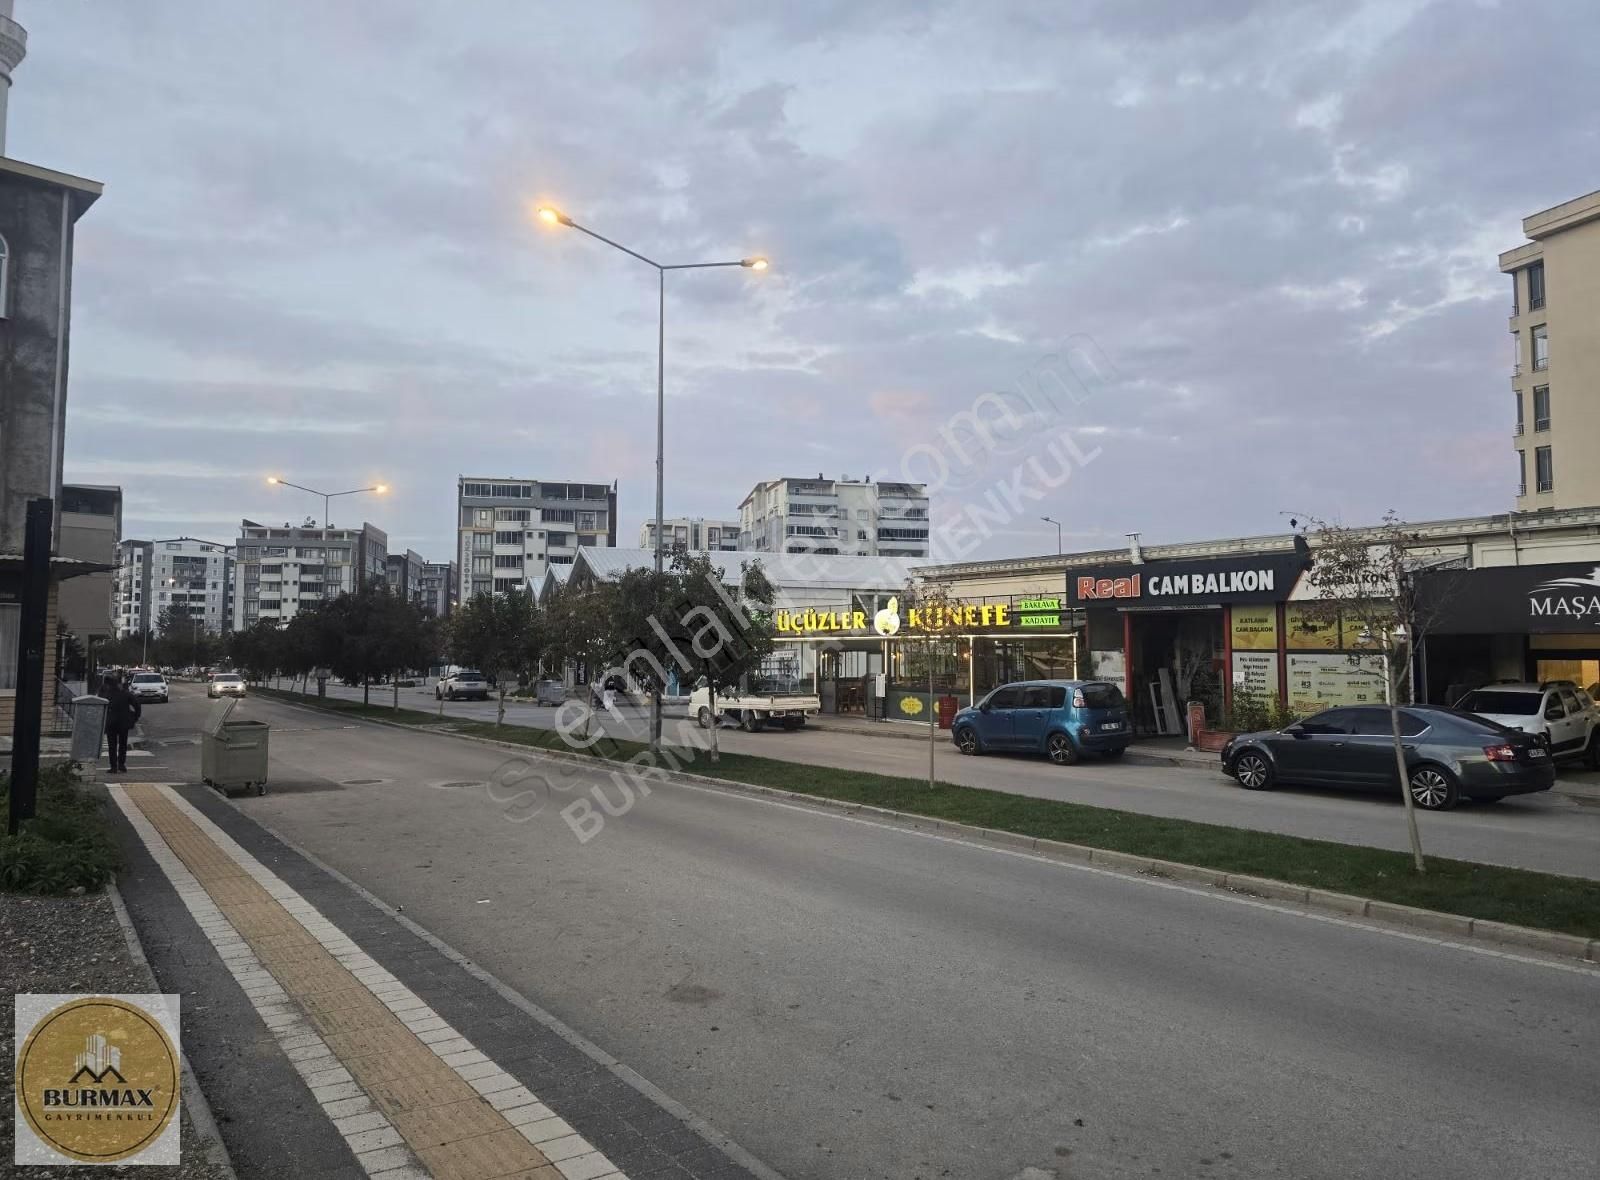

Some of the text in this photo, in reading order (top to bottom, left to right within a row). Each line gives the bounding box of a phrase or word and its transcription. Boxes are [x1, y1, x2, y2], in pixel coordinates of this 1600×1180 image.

[1077, 573, 1141, 600] Real
[1024, 601, 1056, 609] BAKLAVA
[777, 601, 1011, 636] ÜÇÜZLER KÜNEFE
[1024, 617, 1055, 625] KADAYIF
